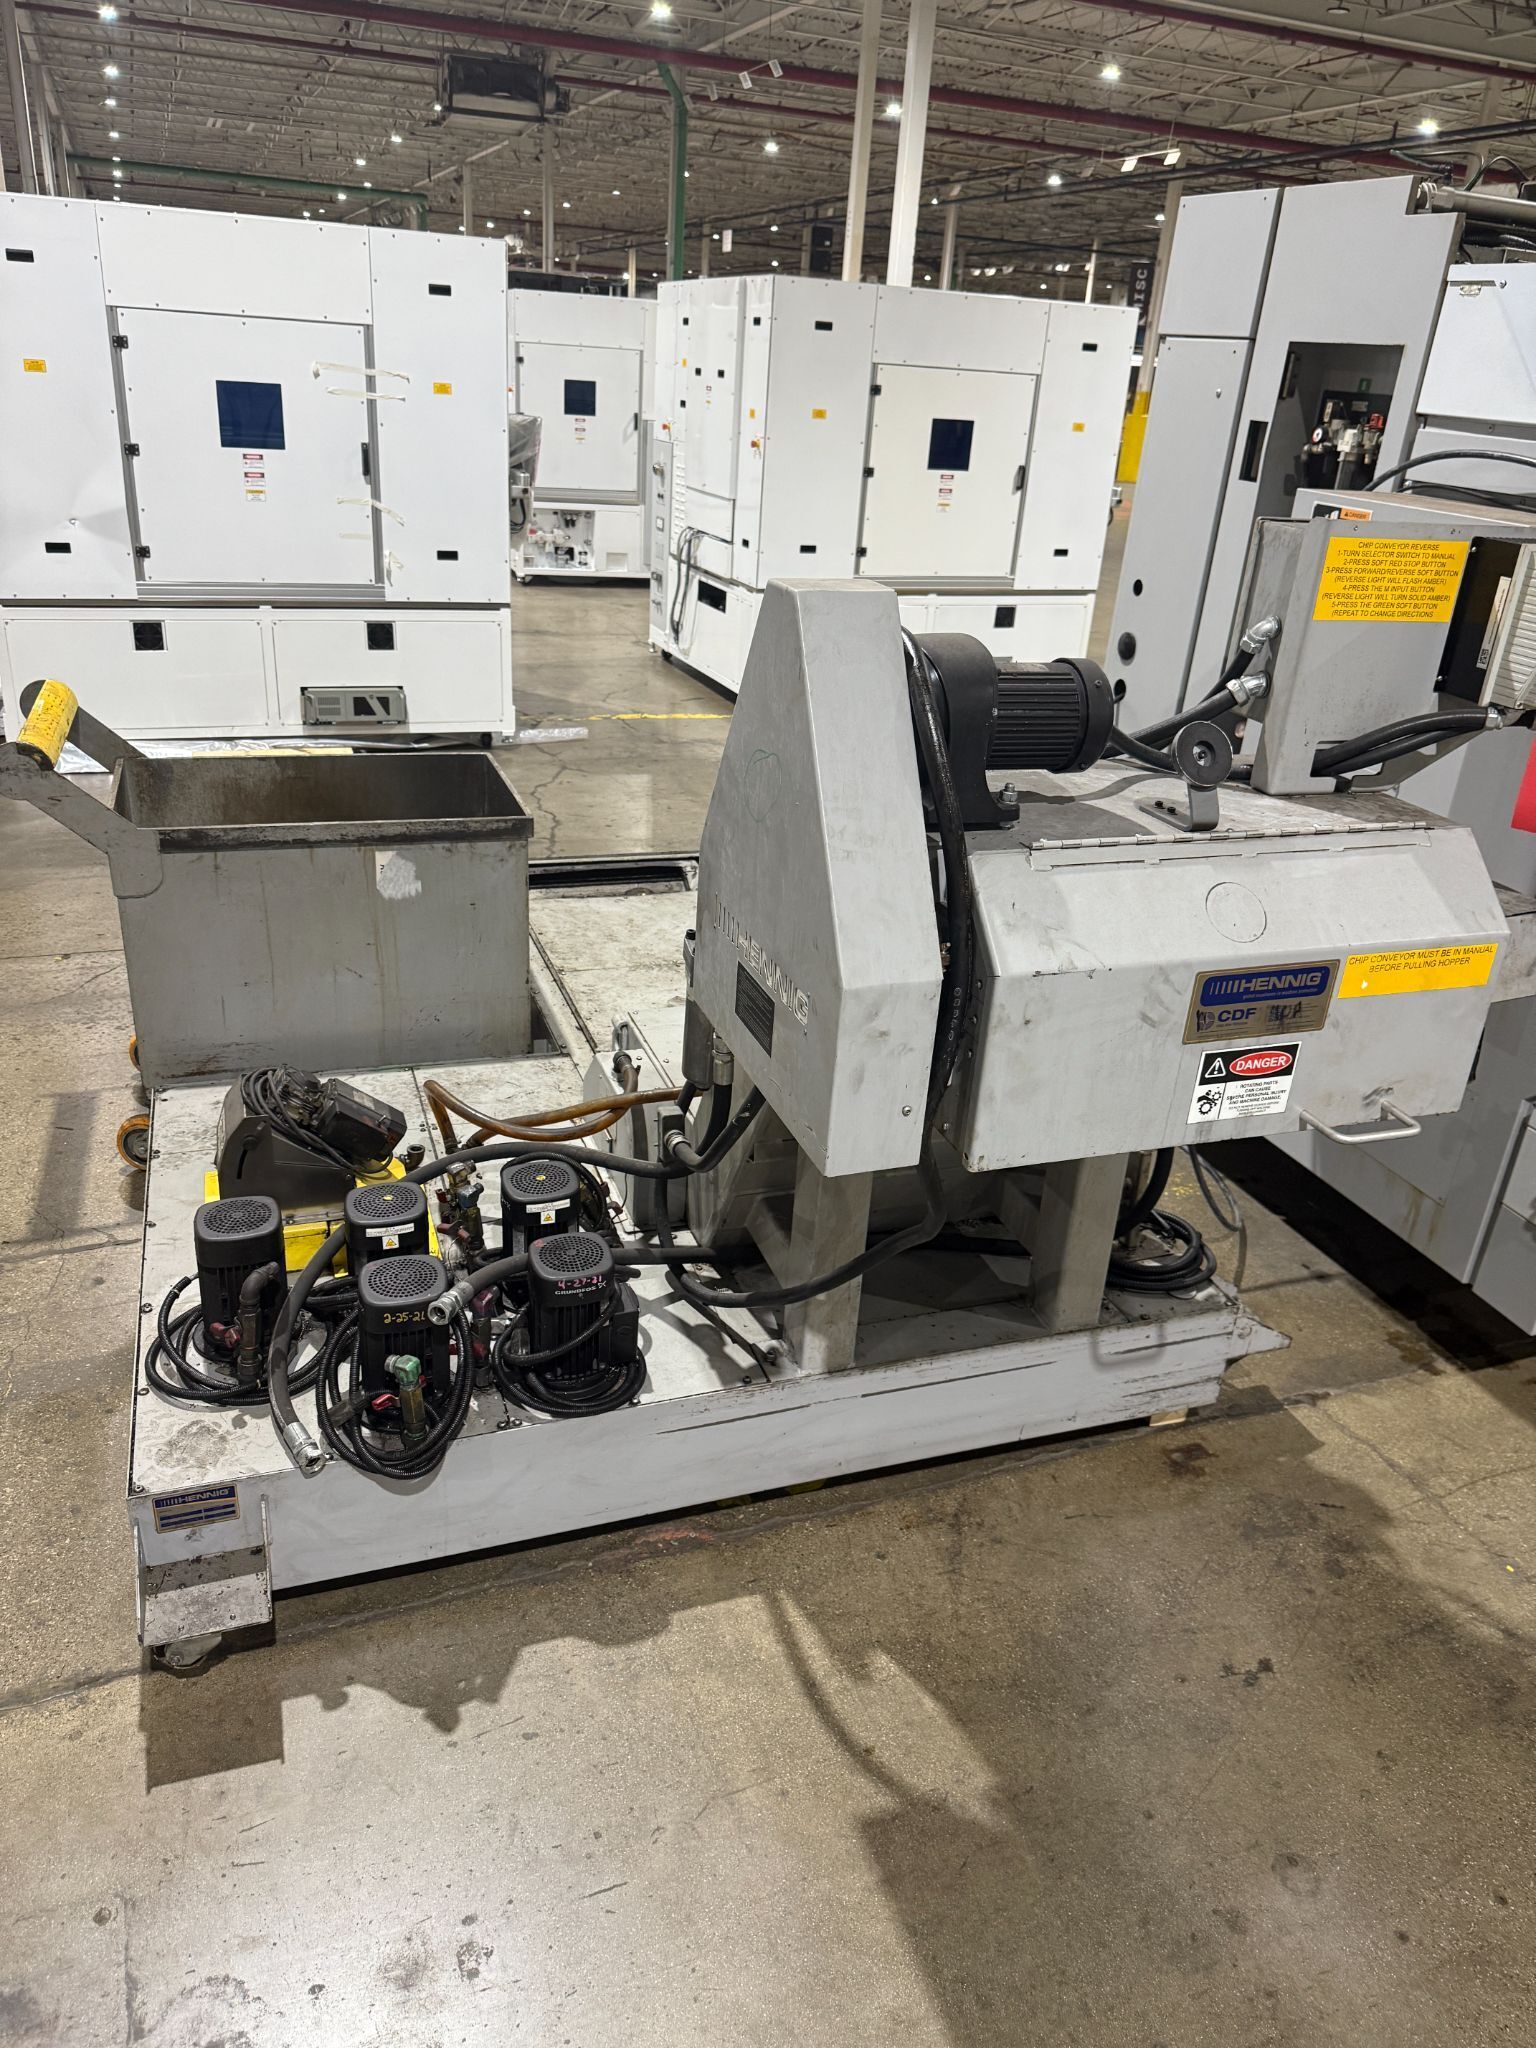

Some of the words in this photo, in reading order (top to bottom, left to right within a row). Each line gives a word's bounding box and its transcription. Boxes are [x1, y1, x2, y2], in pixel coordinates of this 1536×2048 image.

[1349, 957, 1368, 965] CHIP
[1371, 953, 1415, 962] CONVEYOR
[1418, 950, 1439, 958] MUST
[1463, 946, 1493, 954] MANUAL
[1369, 962, 1401, 972] BEFORE
[1403, 960, 1436, 970] PULLING
[1438, 957, 1470, 966] HOPPER
[736, 921, 809, 1025] HENNIG
[1239, 972, 1322, 992] HENNIG
[1218, 1007, 1257, 1022] CDF
[1236, 1056, 1286, 1071] DANGER
[558, 1275, 602, 1289] 4-27-21
[555, 1286, 597, 1295] GRUNDFOS
[383, 1311, 426, 1324] 2-25-21
